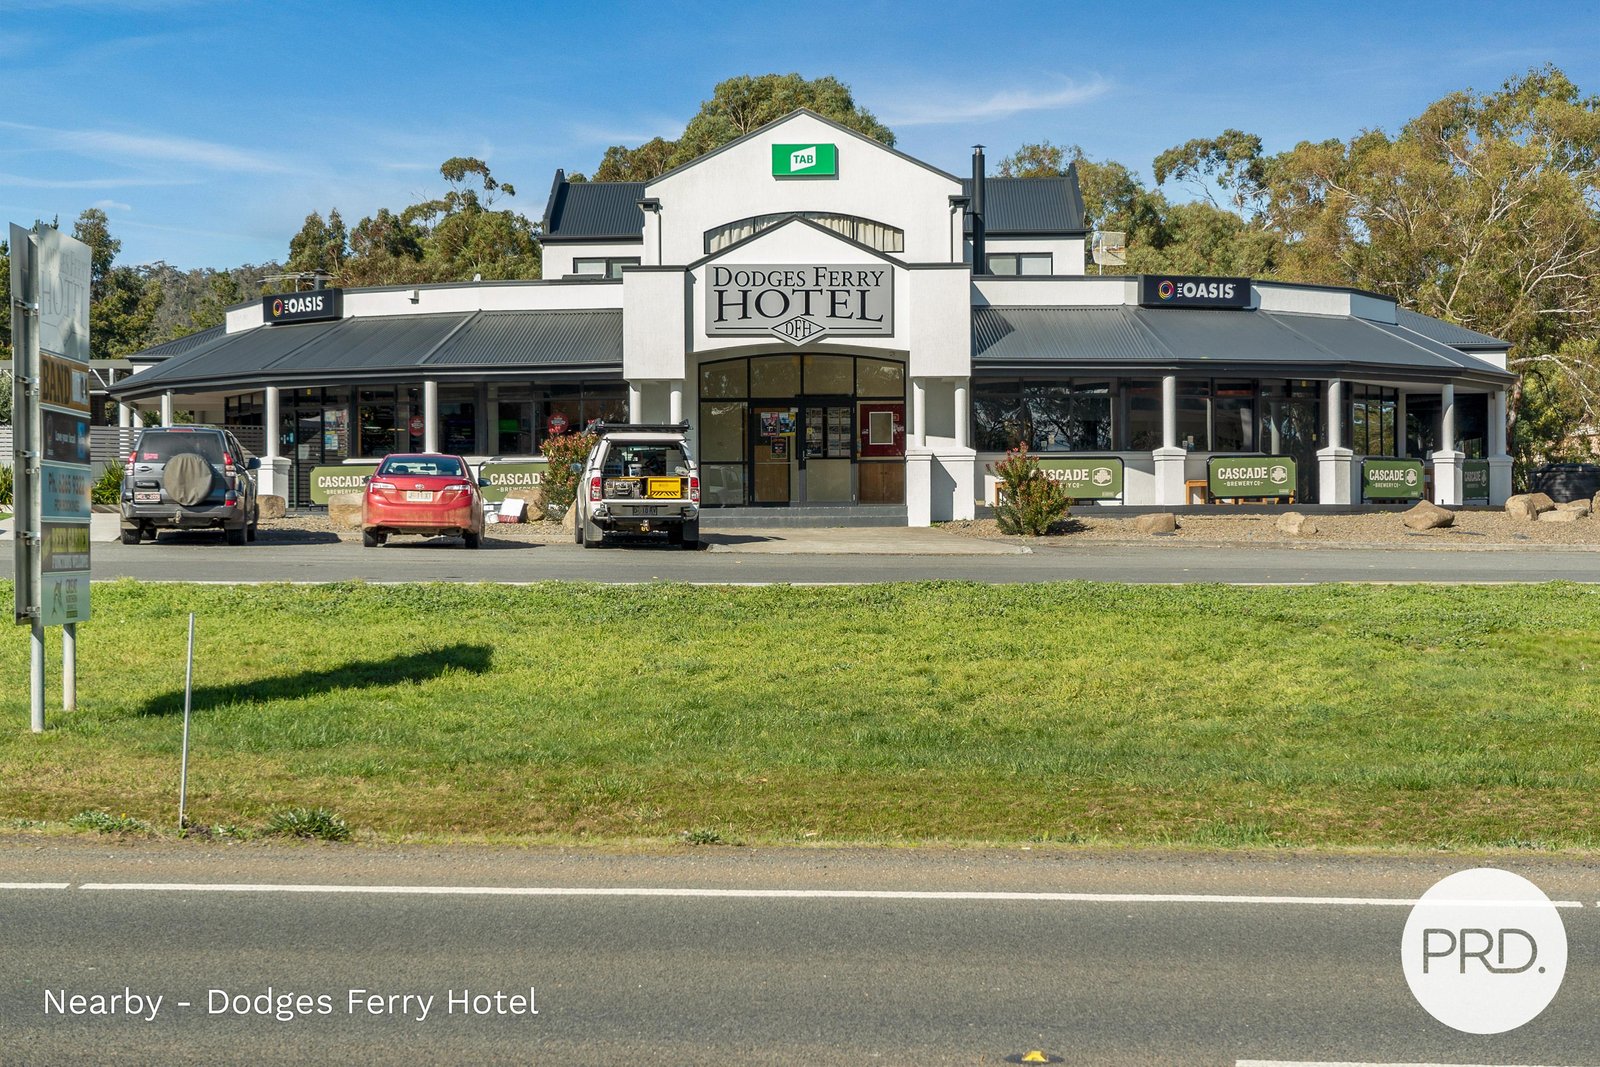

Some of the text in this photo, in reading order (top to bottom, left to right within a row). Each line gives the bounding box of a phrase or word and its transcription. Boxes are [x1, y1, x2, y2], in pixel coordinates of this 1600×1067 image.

[793, 154, 814, 164] TAB
[712, 266, 885, 287] DODGES FERRY
[1183, 282, 1234, 299] OASIS
[289, 296, 323, 313] OASIS
[713, 289, 884, 323] HOTEL
[785, 320, 812, 338] DFH
[42, 359, 70, 405] BAND
[318, 475, 366, 488] CASCADE
[489, 473, 545, 486] CASCAD
[1217, 466, 1268, 480] CASCADE
[1369, 469, 1404, 481] CASCADE
